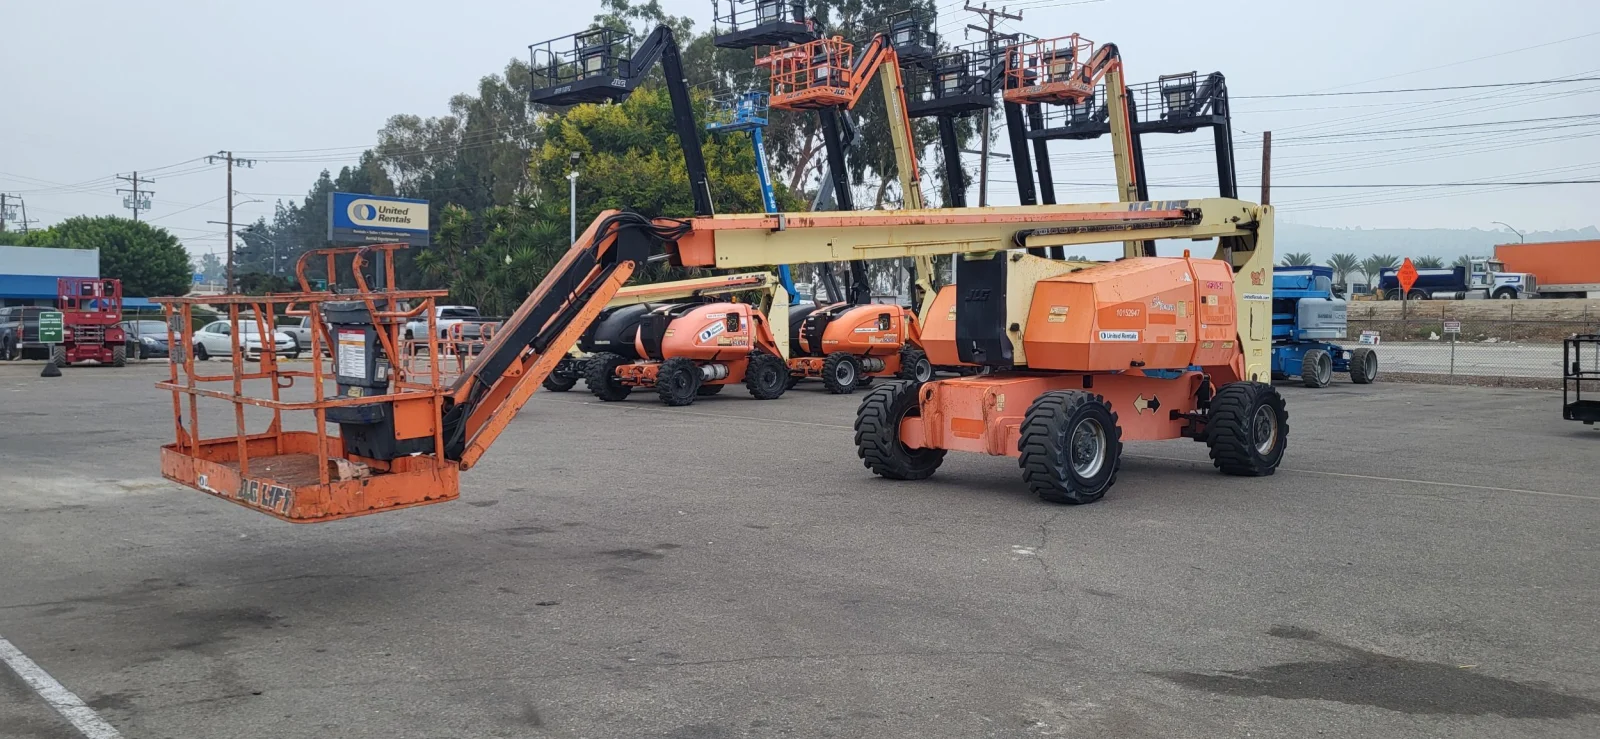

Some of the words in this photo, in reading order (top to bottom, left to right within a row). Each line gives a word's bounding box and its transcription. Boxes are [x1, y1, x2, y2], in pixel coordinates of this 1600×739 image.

[611, 79, 626, 87] JLG
[378, 206, 409, 216] United
[378, 214, 411, 224] Rentals
[965, 288, 991, 301] JLG
[1116, 308, 1141, 317] 10152947
[1106, 332, 1121, 340] United
